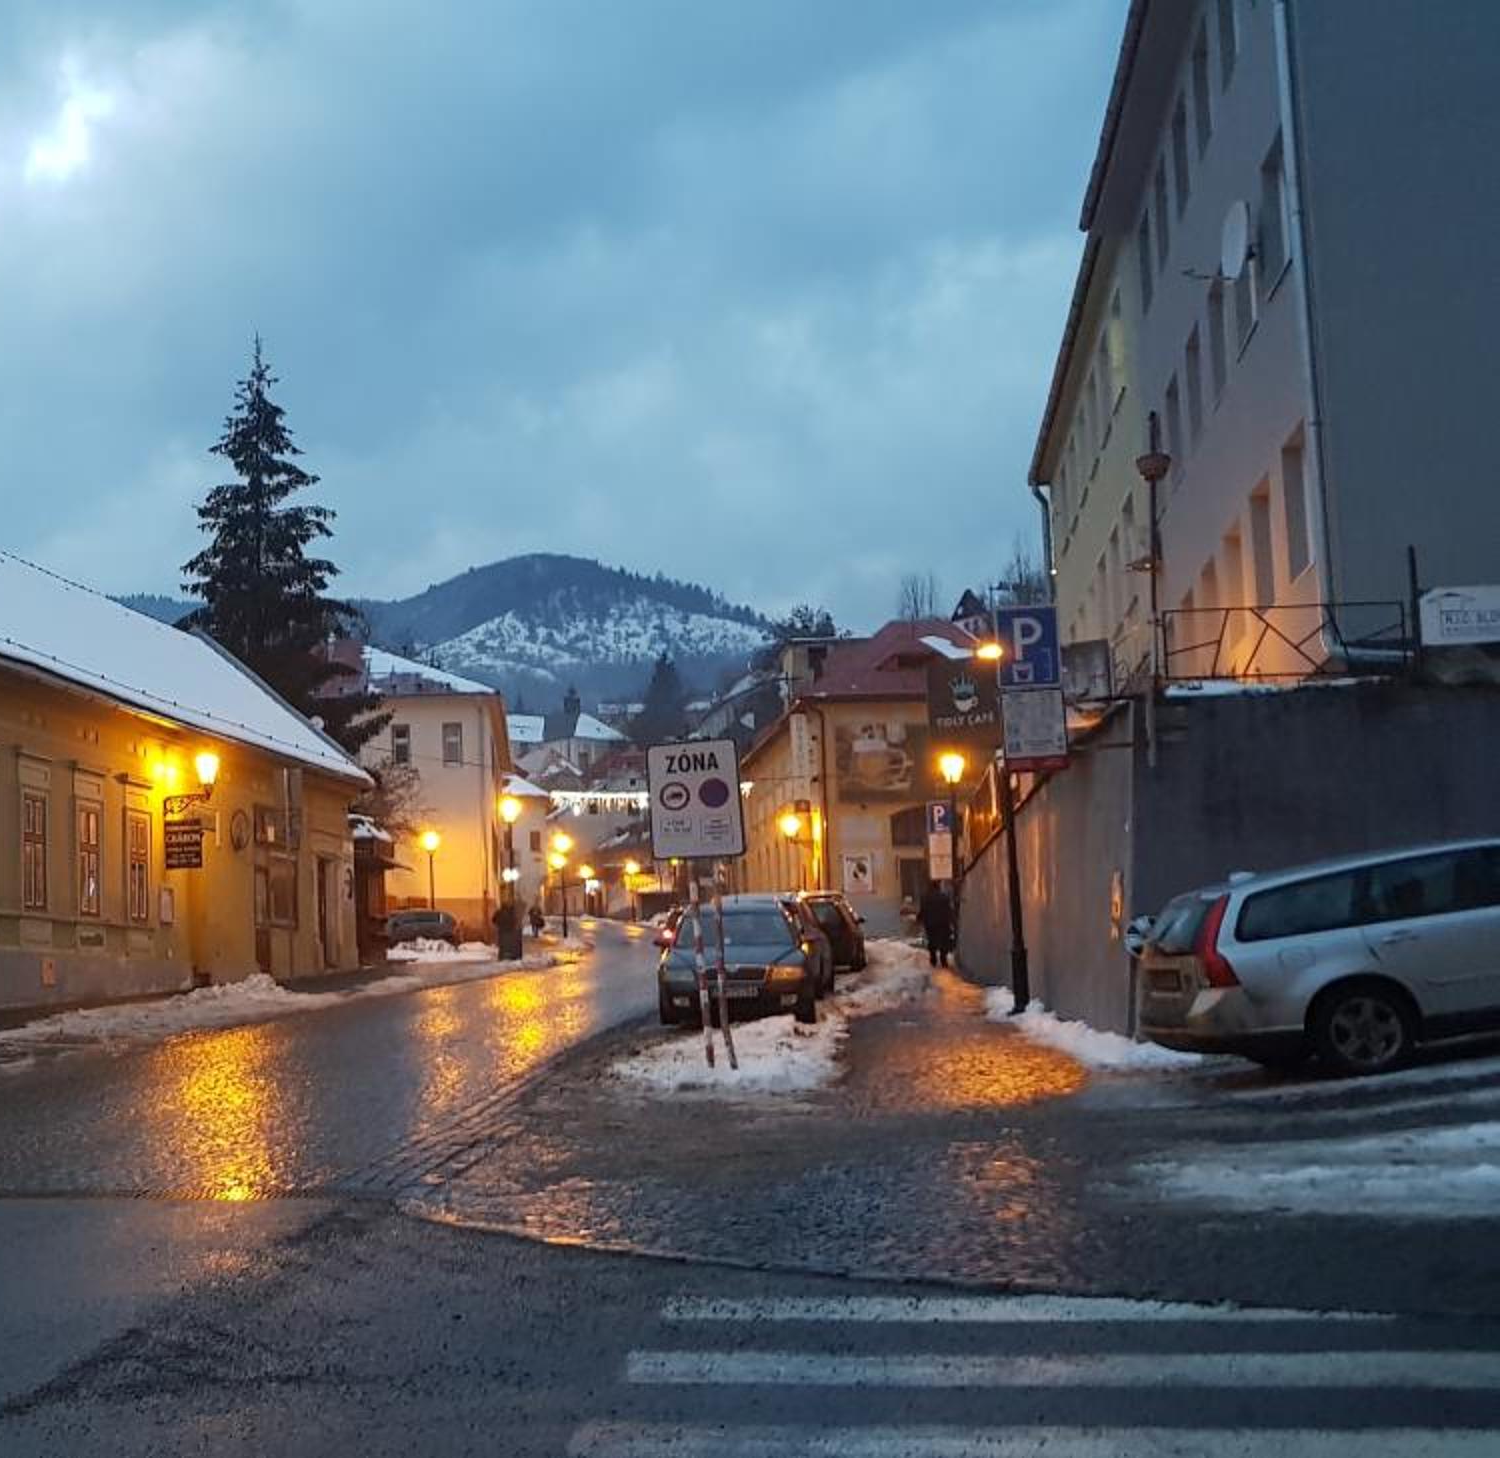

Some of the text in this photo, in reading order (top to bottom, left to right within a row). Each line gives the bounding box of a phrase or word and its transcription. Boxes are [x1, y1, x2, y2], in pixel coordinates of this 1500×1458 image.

[1013, 617, 1043, 661] P
[665, 749, 719, 774] ZÓNA
[932, 805, 945, 823] P
